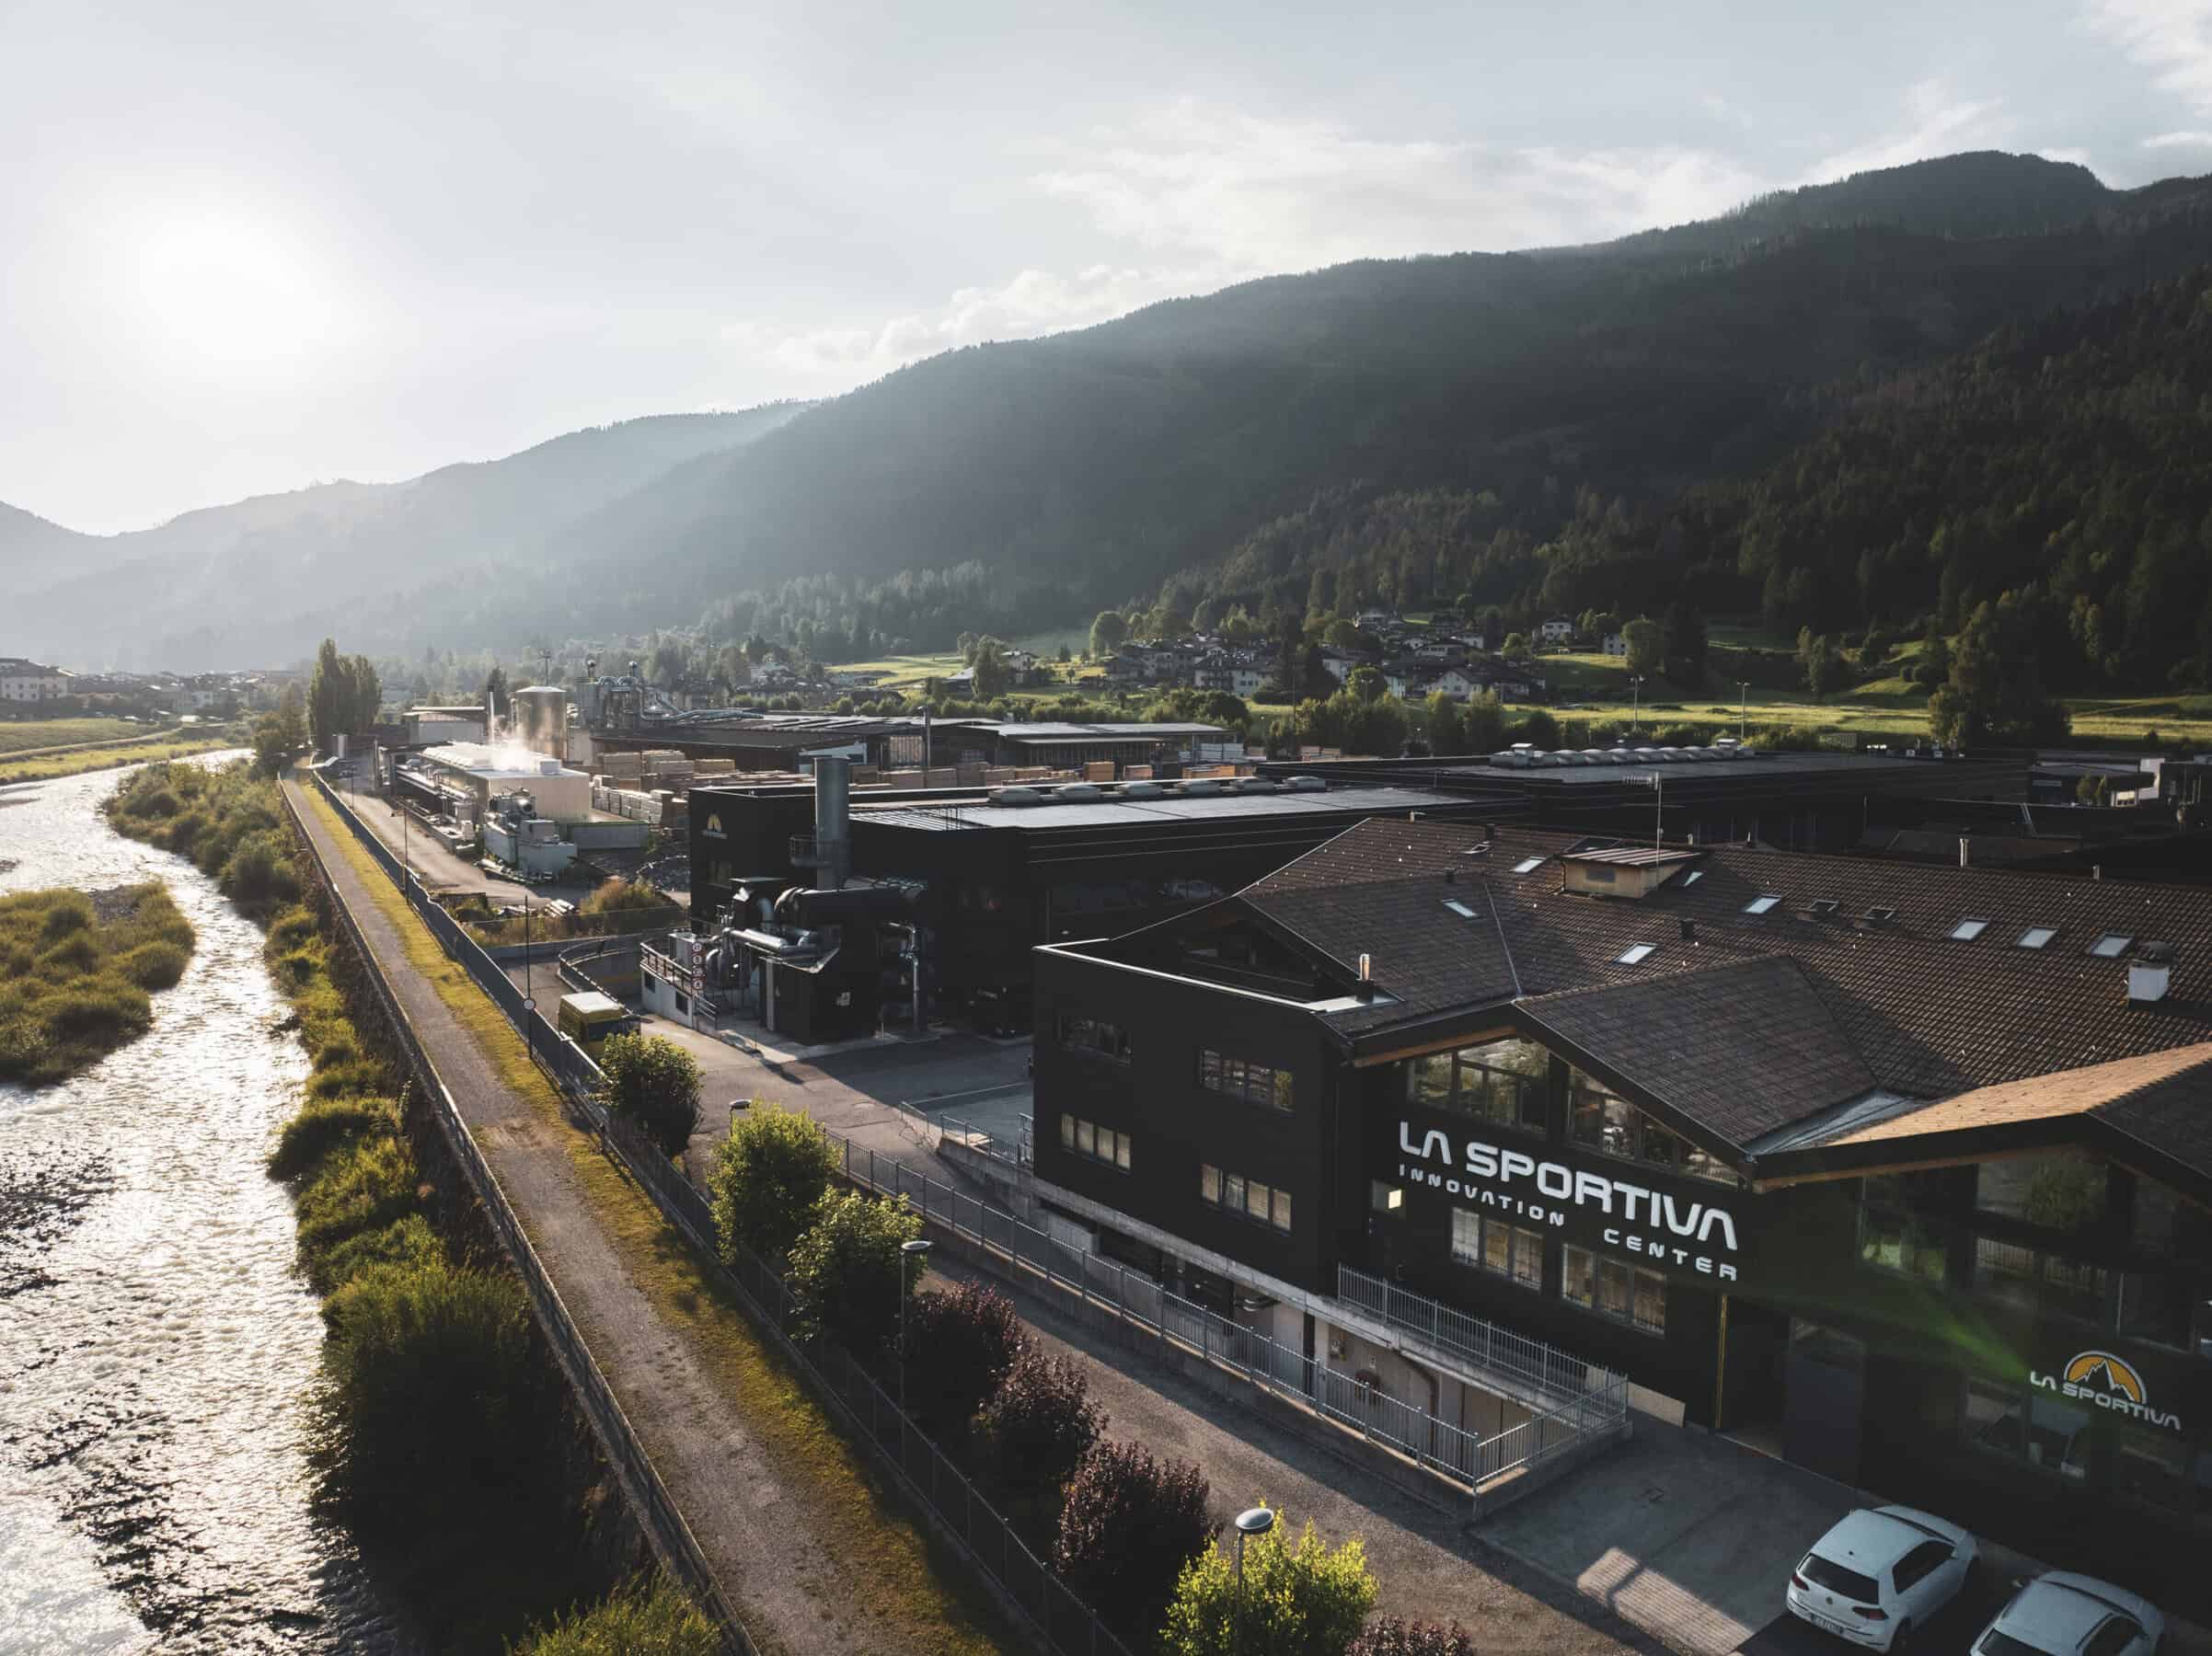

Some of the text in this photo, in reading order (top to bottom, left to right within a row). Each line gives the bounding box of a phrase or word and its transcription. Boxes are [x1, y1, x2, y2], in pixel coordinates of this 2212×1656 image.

[1399, 1163, 1738, 1282] INNOVATION CENTER
[1400, 1121, 1739, 1251] LA SPORTIVA
[2030, 1370, 2182, 1431] LA SPORTIVA
